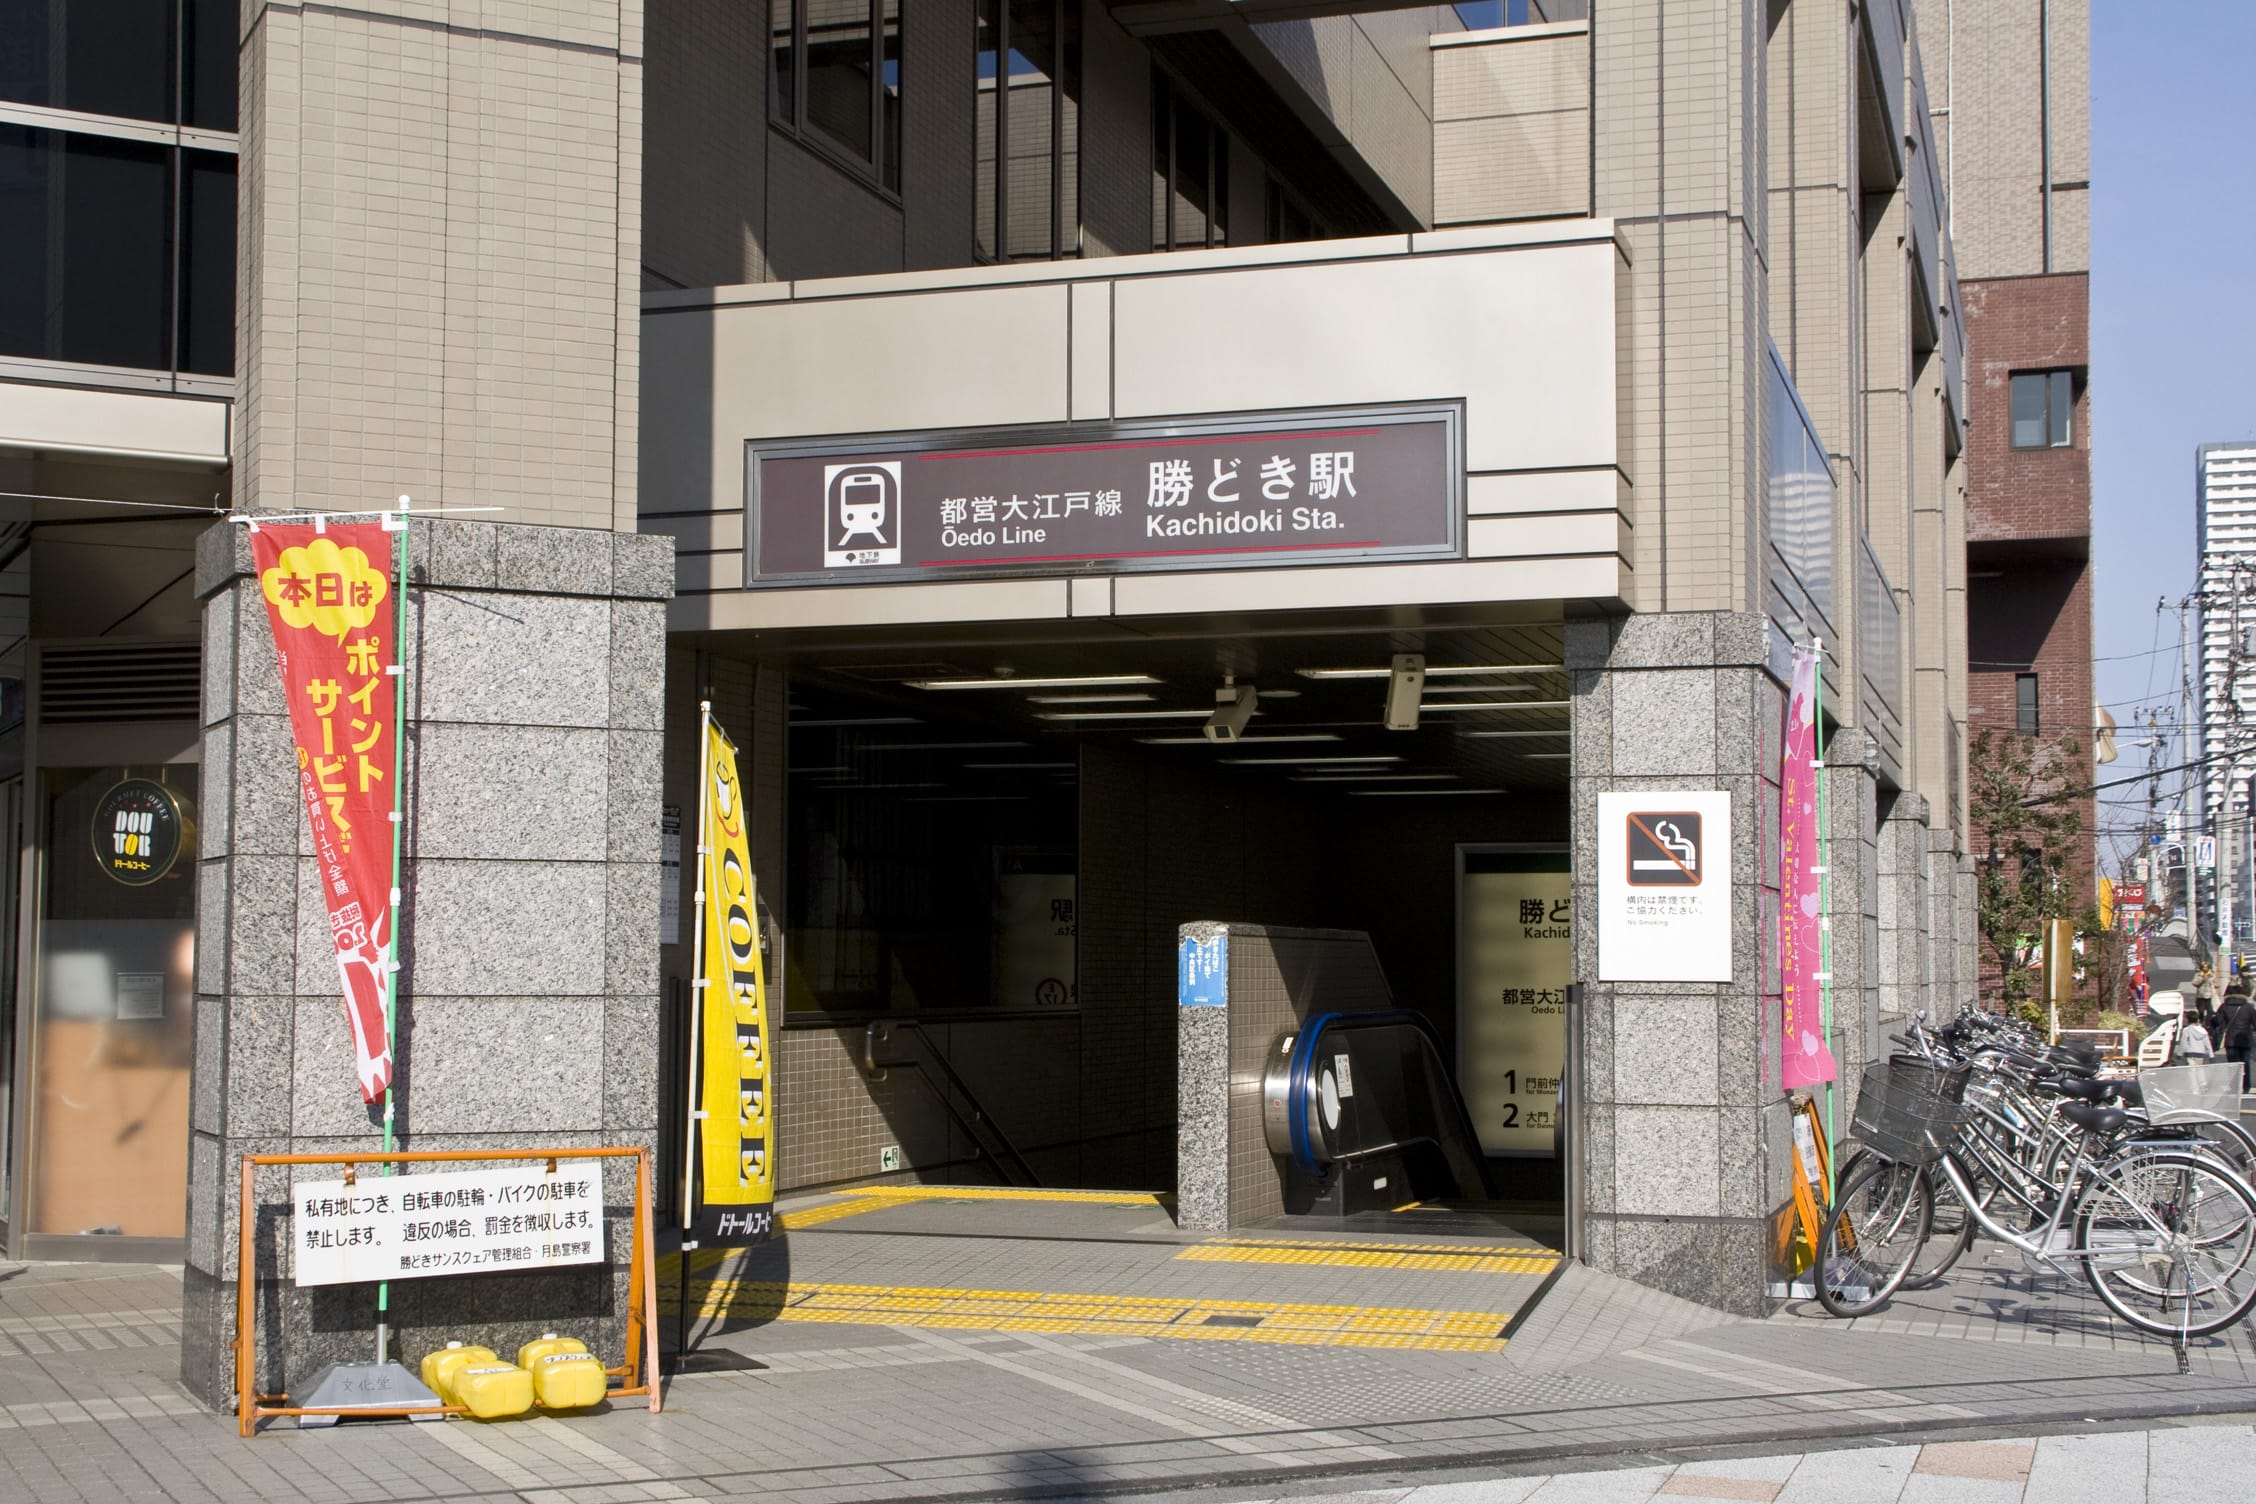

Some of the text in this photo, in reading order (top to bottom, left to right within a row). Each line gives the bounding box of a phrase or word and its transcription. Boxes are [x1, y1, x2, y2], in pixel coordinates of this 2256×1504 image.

[1147, 451, 1357, 508] 勝どき駅
[940, 489, 1122, 525] 都営大江戸線
[1146, 506, 1344, 537] Kachidoki Sta.
[941, 526, 1046, 547] Ōedo Line
[277, 571, 372, 608] 本日は
[345, 636, 384, 793] ポイント
[1627, 895, 1703, 905] 構内は禁煙です。
[1627, 906, 1703, 915] ご協力ください。
[724, 847, 766, 1188] COFFEE
[1785, 983, 1795, 1040] Day
[1504, 1069, 1516, 1095] 1
[1503, 1103, 1520, 1128] 2
[306, 1226, 382, 1249] 禁止します。
[342, 1375, 392, 1393] 文化堂
